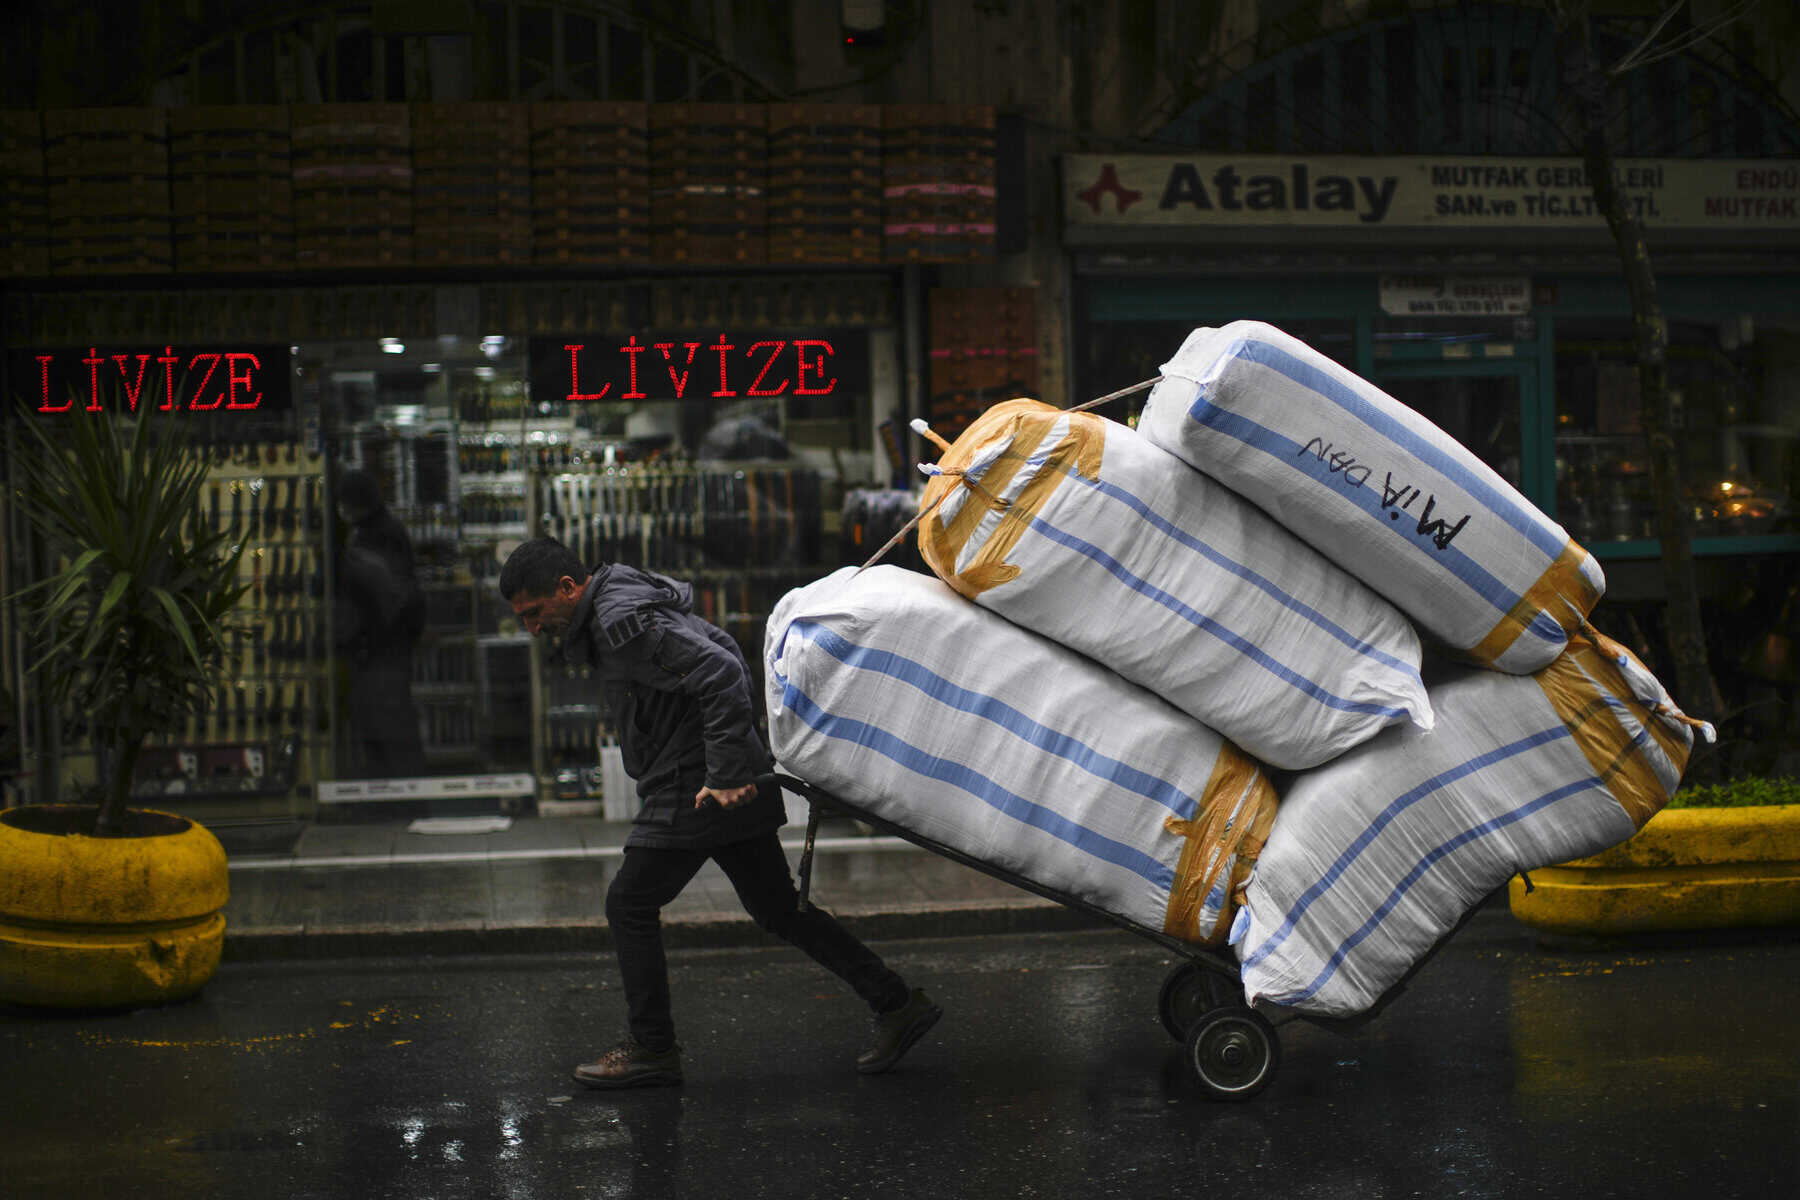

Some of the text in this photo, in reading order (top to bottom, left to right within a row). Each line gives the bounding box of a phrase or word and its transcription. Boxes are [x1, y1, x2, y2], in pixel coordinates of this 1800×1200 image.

[1159, 162, 1397, 223] Atalay
[1431, 165, 1529, 188] MUTFAK
[35, 345, 263, 412] LİVİZE
[563, 332, 838, 400] LİVİZE
[1297, 436, 1372, 488] DAN
